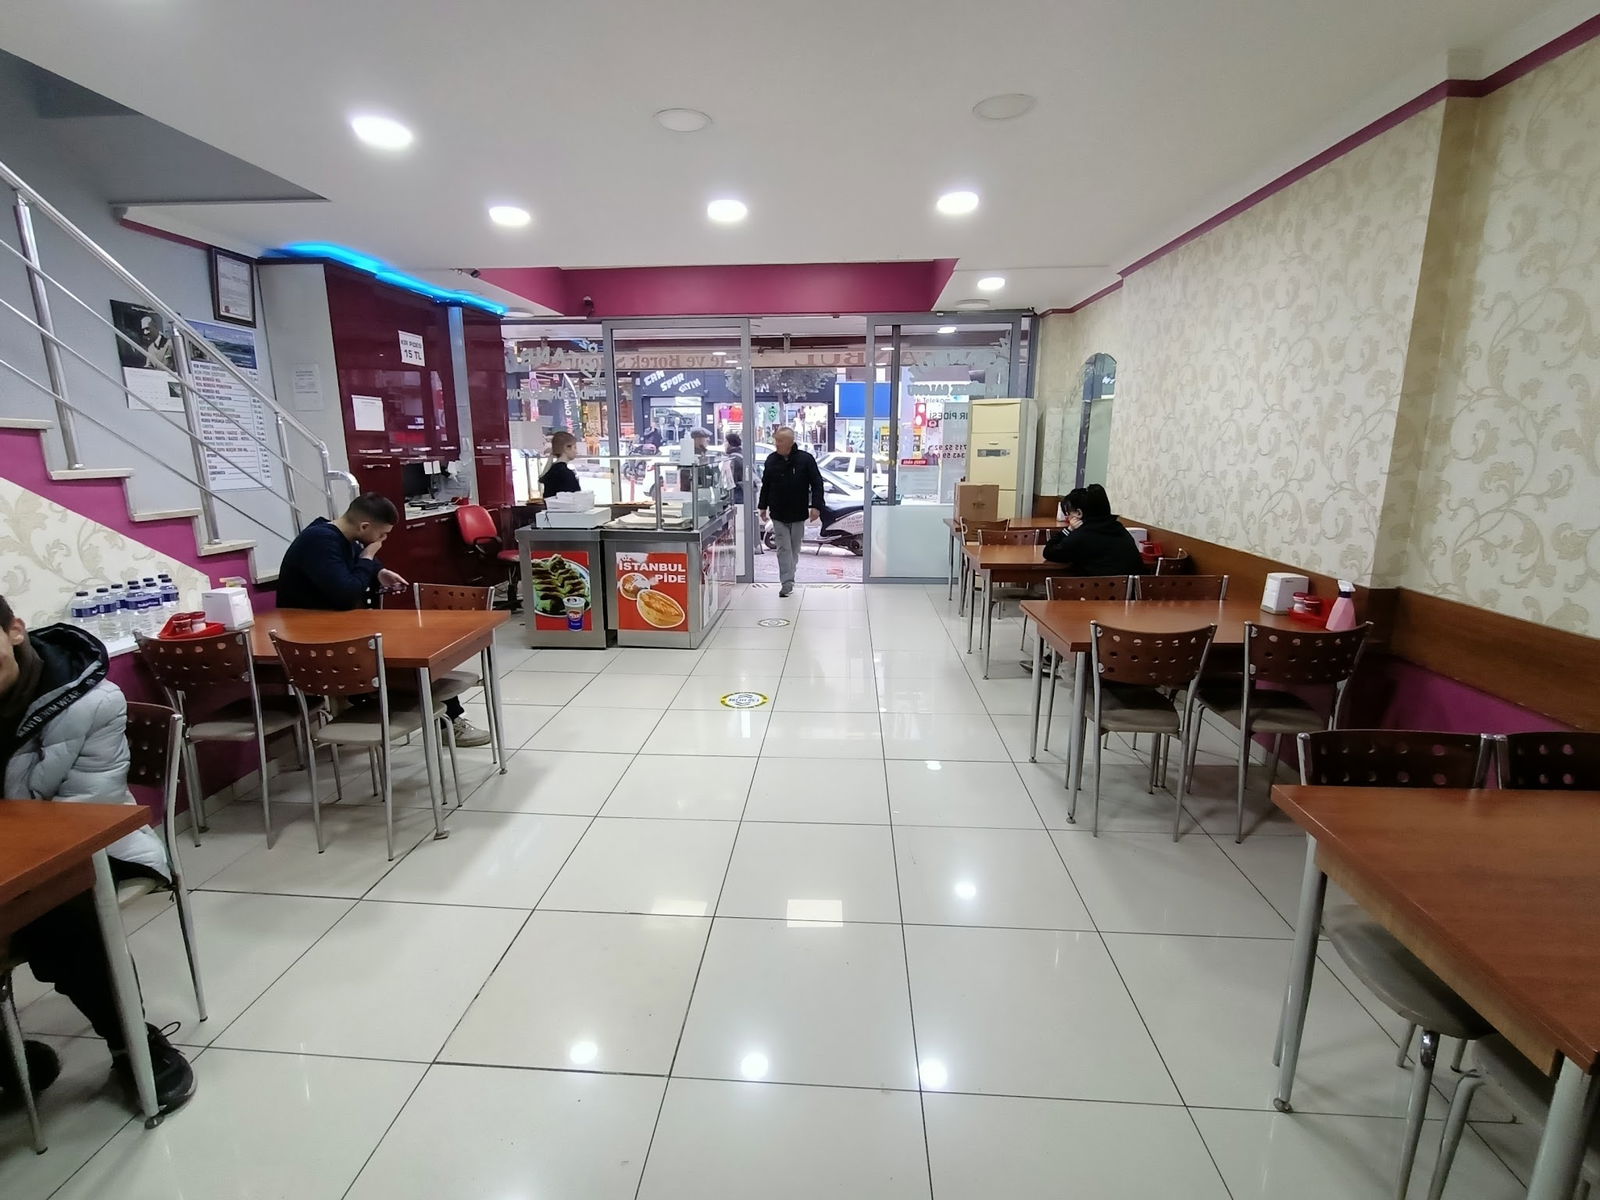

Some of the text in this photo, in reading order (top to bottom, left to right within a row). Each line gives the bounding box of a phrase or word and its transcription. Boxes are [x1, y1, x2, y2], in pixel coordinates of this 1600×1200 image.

[404, 350, 422, 360] 15 TL
[643, 370, 665, 386] CAN
[660, 372, 685, 391] SPOR
[655, 573, 686, 583] PİDE
